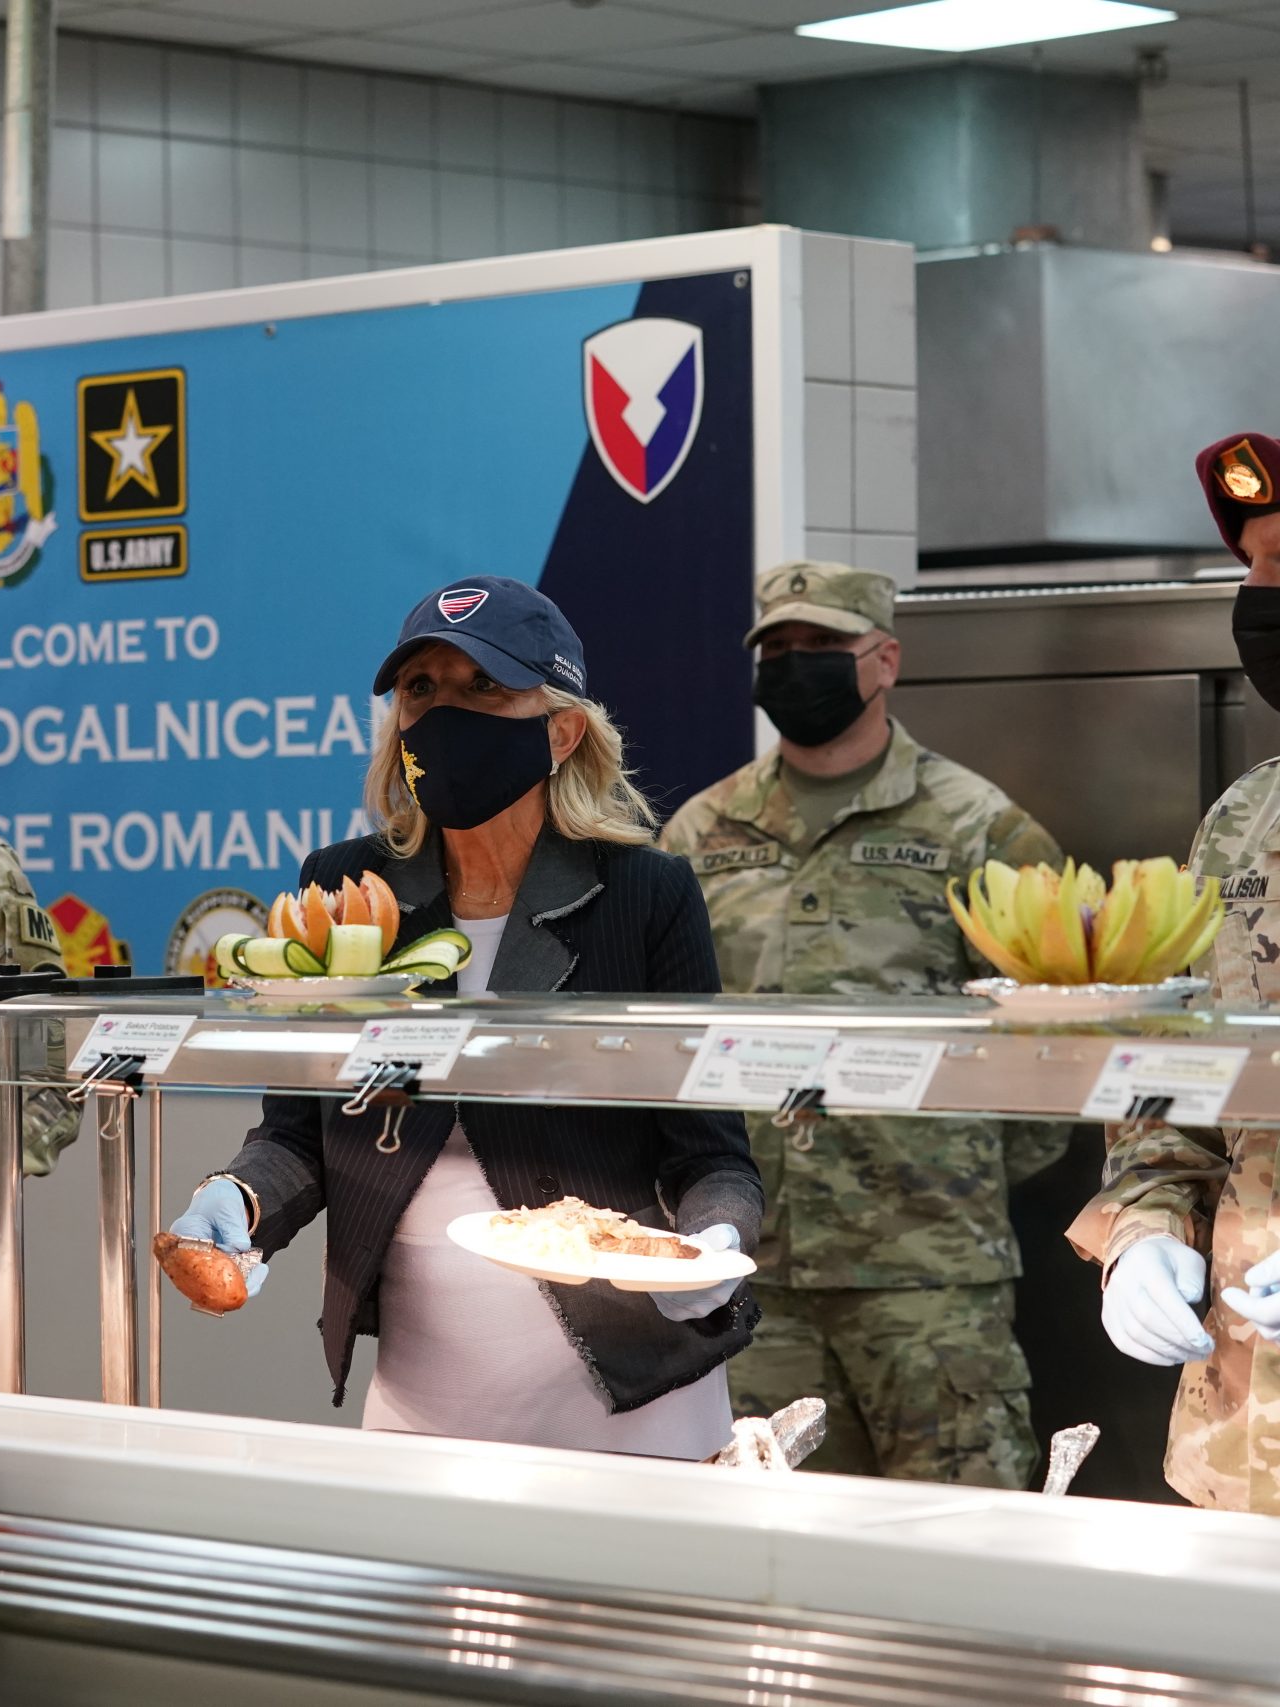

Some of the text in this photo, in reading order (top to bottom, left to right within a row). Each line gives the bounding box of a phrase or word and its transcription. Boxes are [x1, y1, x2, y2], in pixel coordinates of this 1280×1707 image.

[155, 614, 220, 662] TO
[554, 653, 572, 669] BEAU
[893, 846, 938, 867] ARMY
[27, 907, 55, 943] MP
